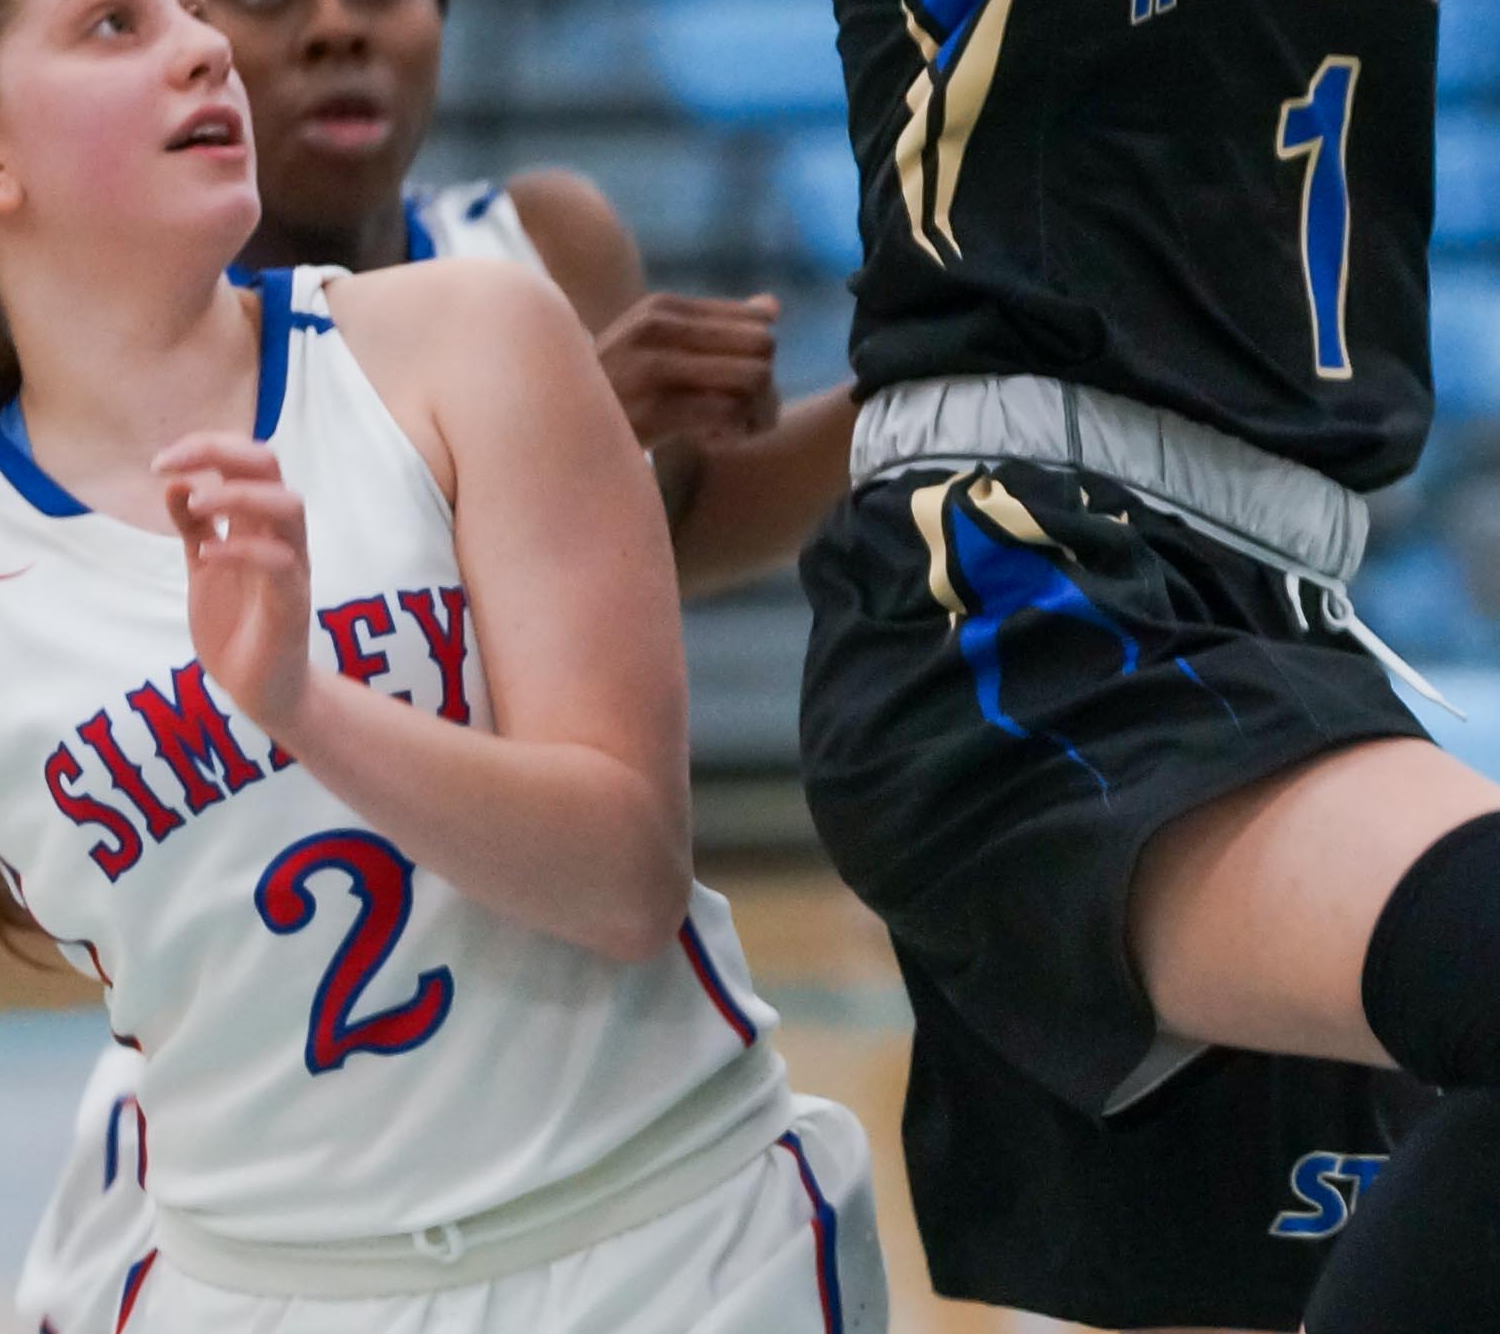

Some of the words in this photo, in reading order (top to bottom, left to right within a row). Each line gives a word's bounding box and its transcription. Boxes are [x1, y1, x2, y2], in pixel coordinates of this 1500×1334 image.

[1274, 54, 1361, 379] 1
[43, 584, 469, 884] SIMEY
[254, 826, 455, 1077] 2
